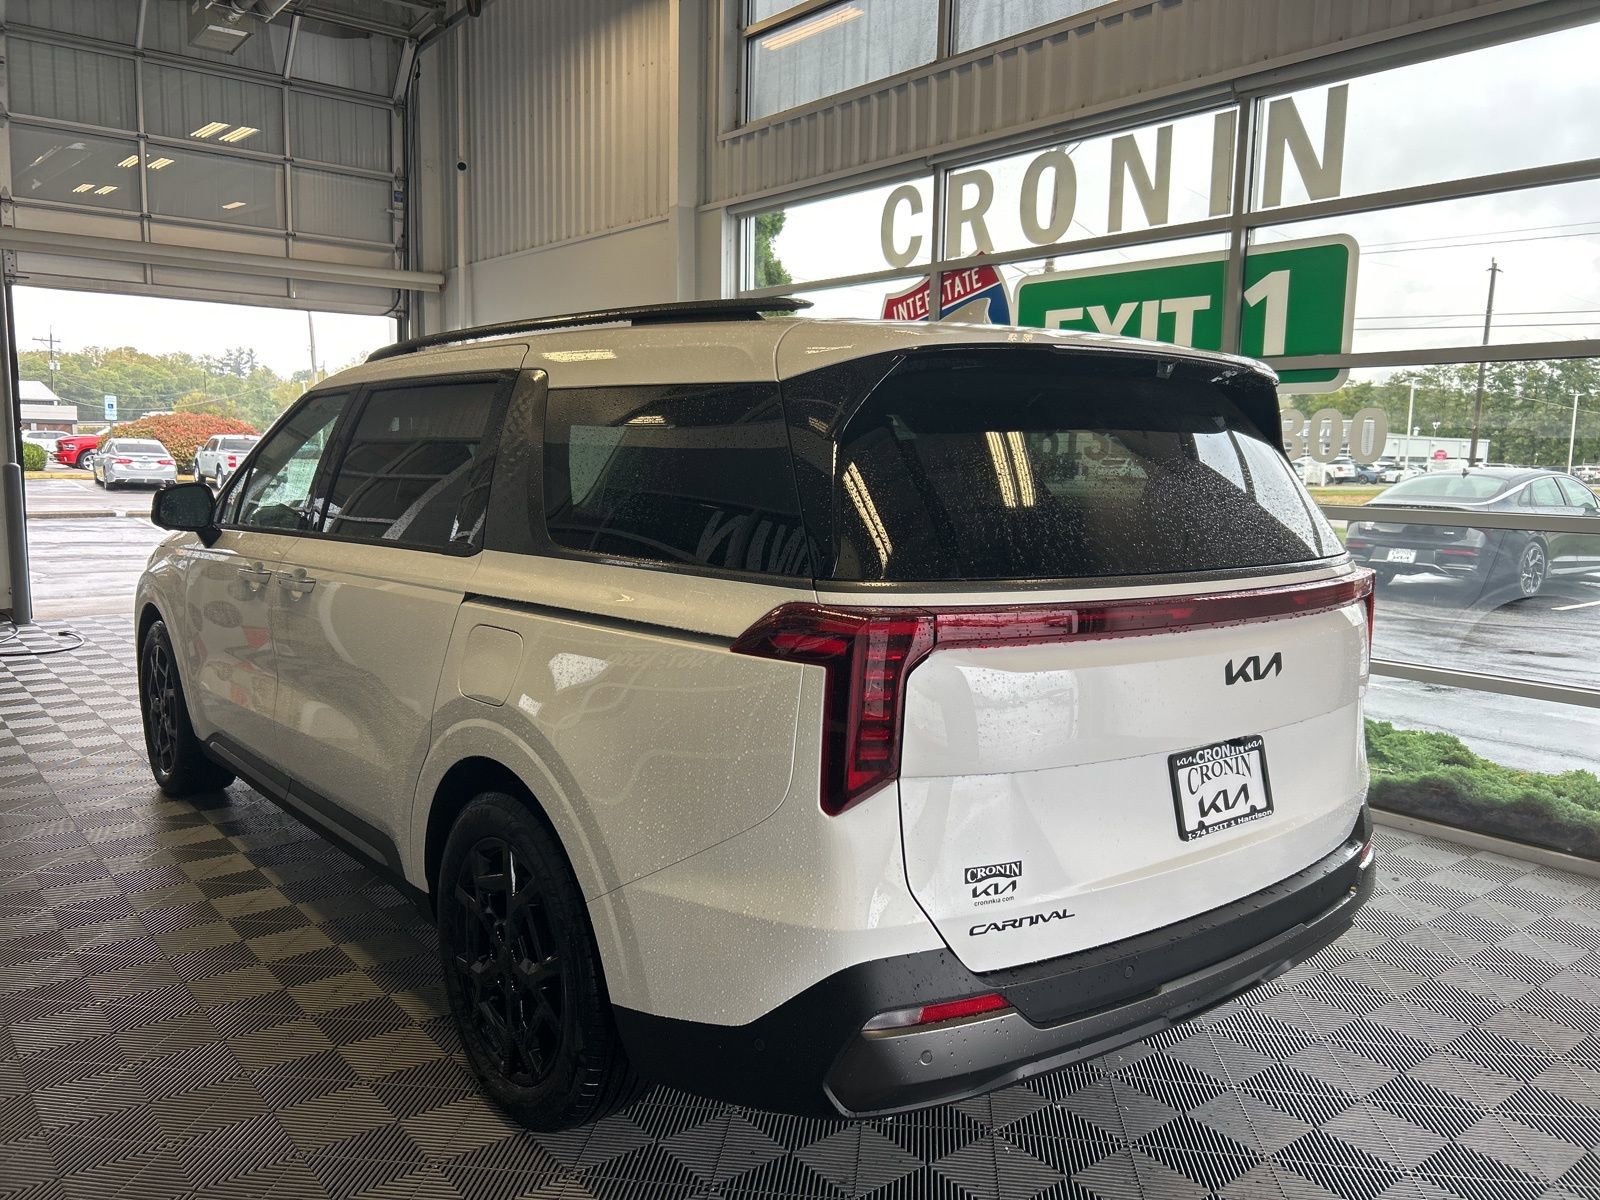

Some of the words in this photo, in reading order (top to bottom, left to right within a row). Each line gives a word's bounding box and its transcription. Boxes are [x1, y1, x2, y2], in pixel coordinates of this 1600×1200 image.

[881, 83, 1349, 268] CRONIN
[893, 267, 982, 320] INTETATE
[1243, 269, 1290, 356] 1
[1225, 652, 1282, 685] KIA
[1196, 744, 1244, 764] CRONIN
[1187, 753, 1252, 795] CRONIN
[1198, 783, 1250, 818] KIA
[1188, 829, 1207, 840] I-74
[1208, 822, 1227, 833] EXIT
[1229, 819, 1236, 827] 1
[1238, 809, 1272, 824] Harrison
[967, 862, 1021, 883] CRONIN
[972, 880, 1017, 899] KIA
[974, 895, 1015, 907] croninkia.com
[969, 909, 1075, 937] CARNIVAL
